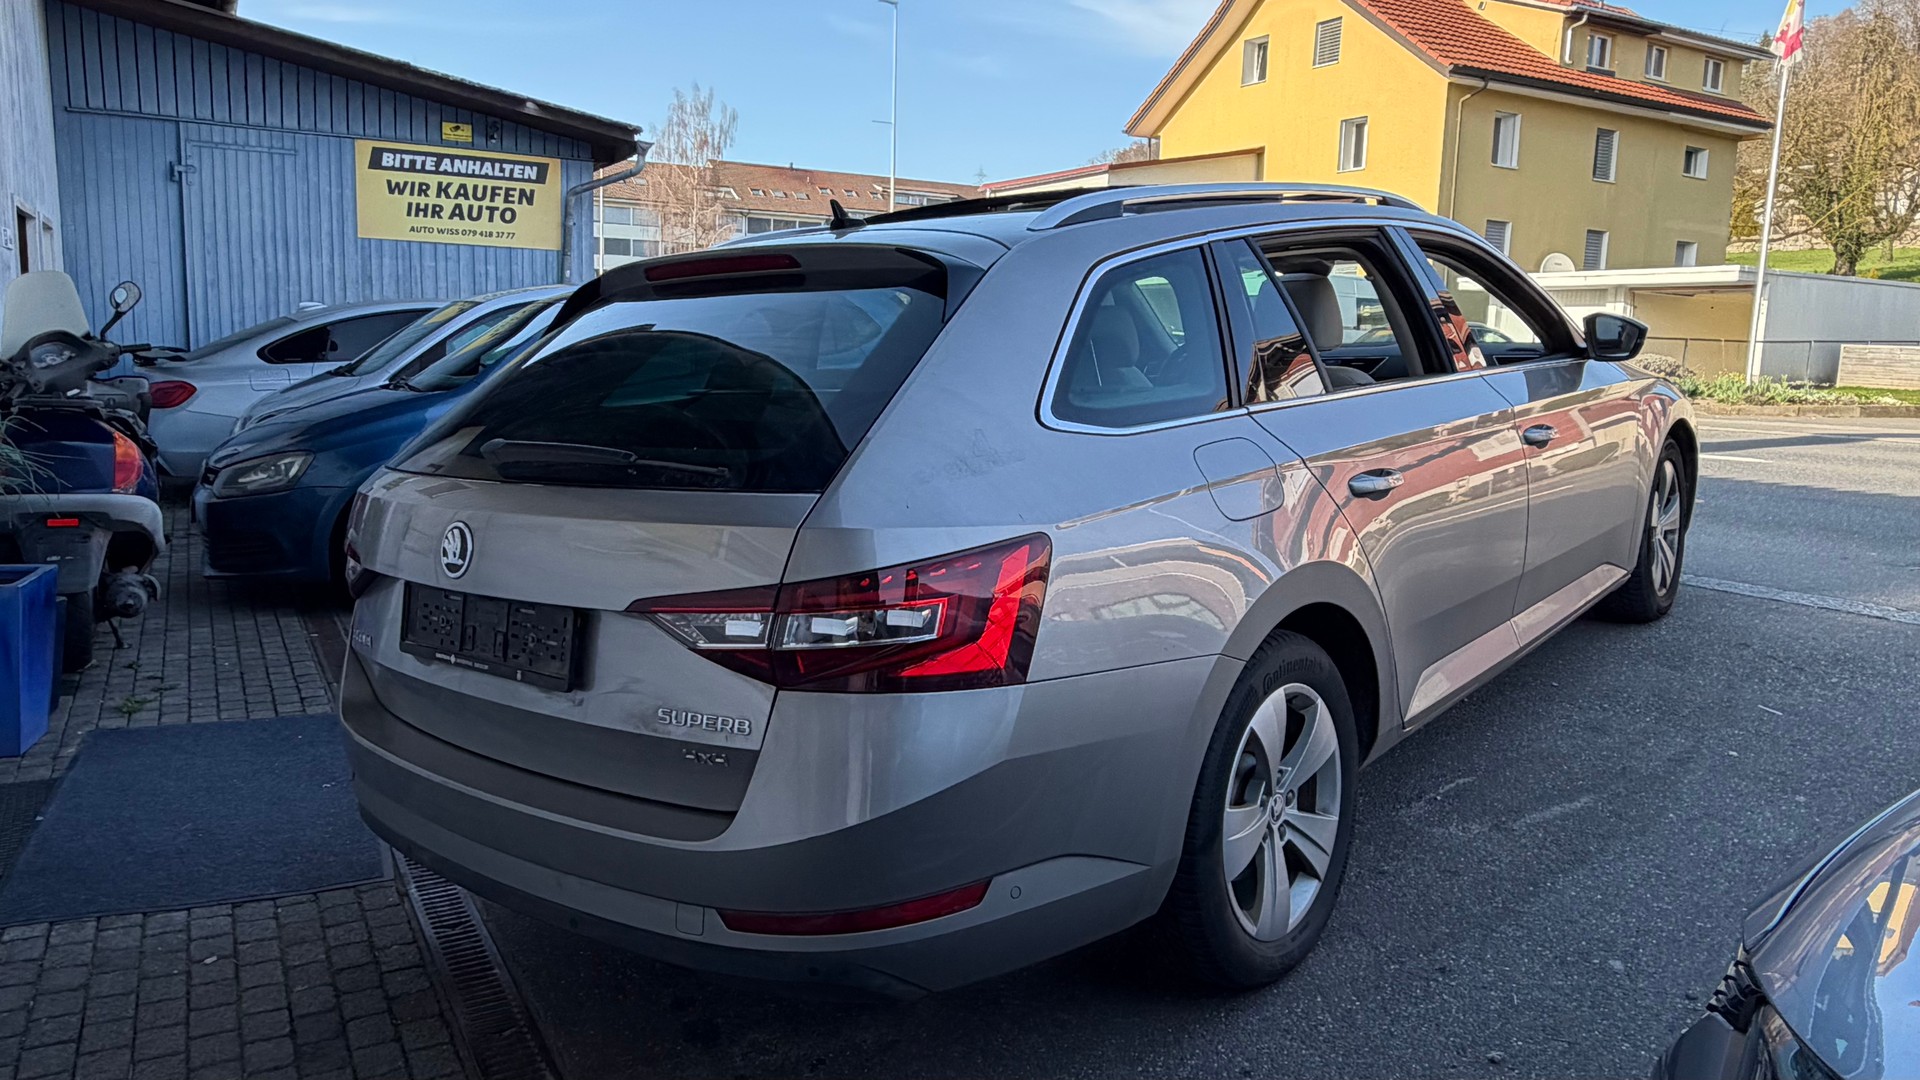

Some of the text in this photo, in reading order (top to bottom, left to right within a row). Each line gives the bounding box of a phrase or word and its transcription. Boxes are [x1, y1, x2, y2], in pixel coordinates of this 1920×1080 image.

[381, 152, 538, 180] BITTE ANHALTEN
[386, 179, 536, 206] WIR KAUFEN
[406, 202, 518, 224] IHR AUTO
[409, 225, 434, 234] AUTO
[436, 227, 460, 236] WISS
[461, 229, 477, 237] 079
[478, 230, 493, 238] 418
[494, 231, 504, 239] 37
[1263, 656, 1316, 695] Continental
[657, 708, 752, 736] SUPERB
